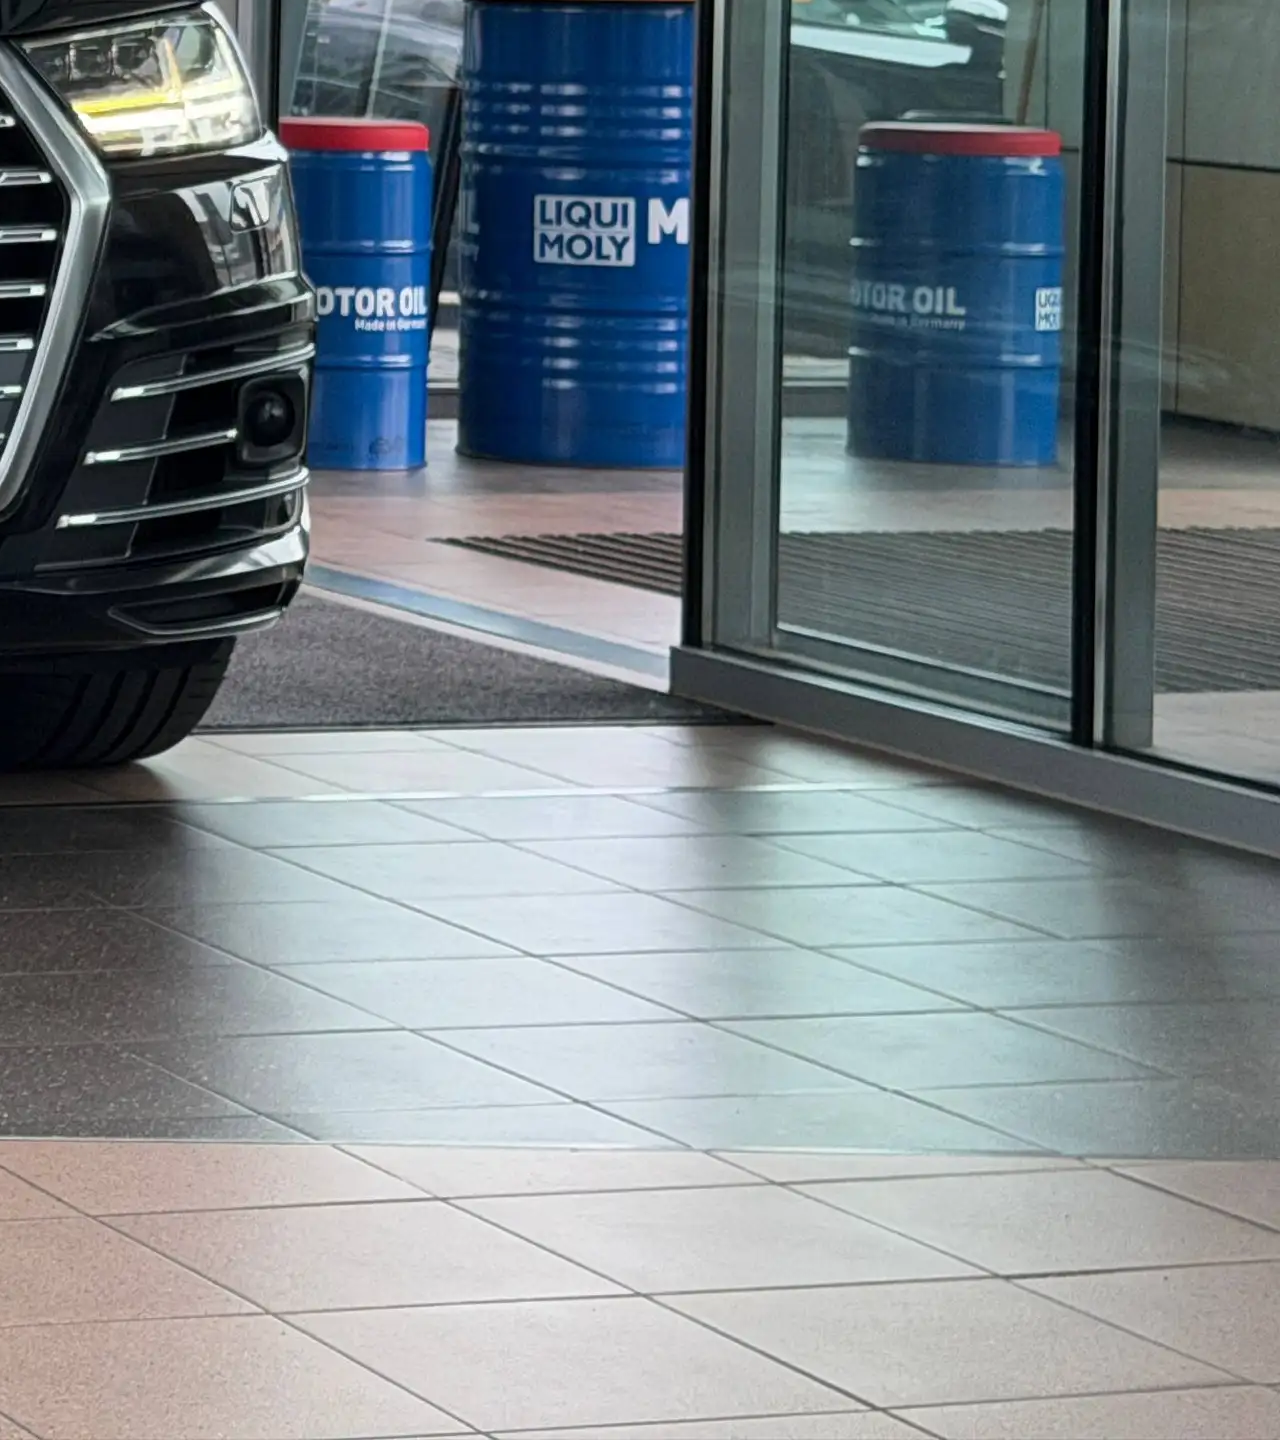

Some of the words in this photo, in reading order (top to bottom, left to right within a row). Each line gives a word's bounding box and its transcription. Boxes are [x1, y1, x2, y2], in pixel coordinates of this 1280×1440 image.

[540, 200, 629, 230] LIQUI
[540, 233, 630, 261] MOLY
[316, 286, 395, 317] OTOR
[400, 286, 427, 316] OIL
[851, 280, 907, 313] OTOR
[912, 286, 966, 316] OIL
[354, 317, 385, 331] Made
